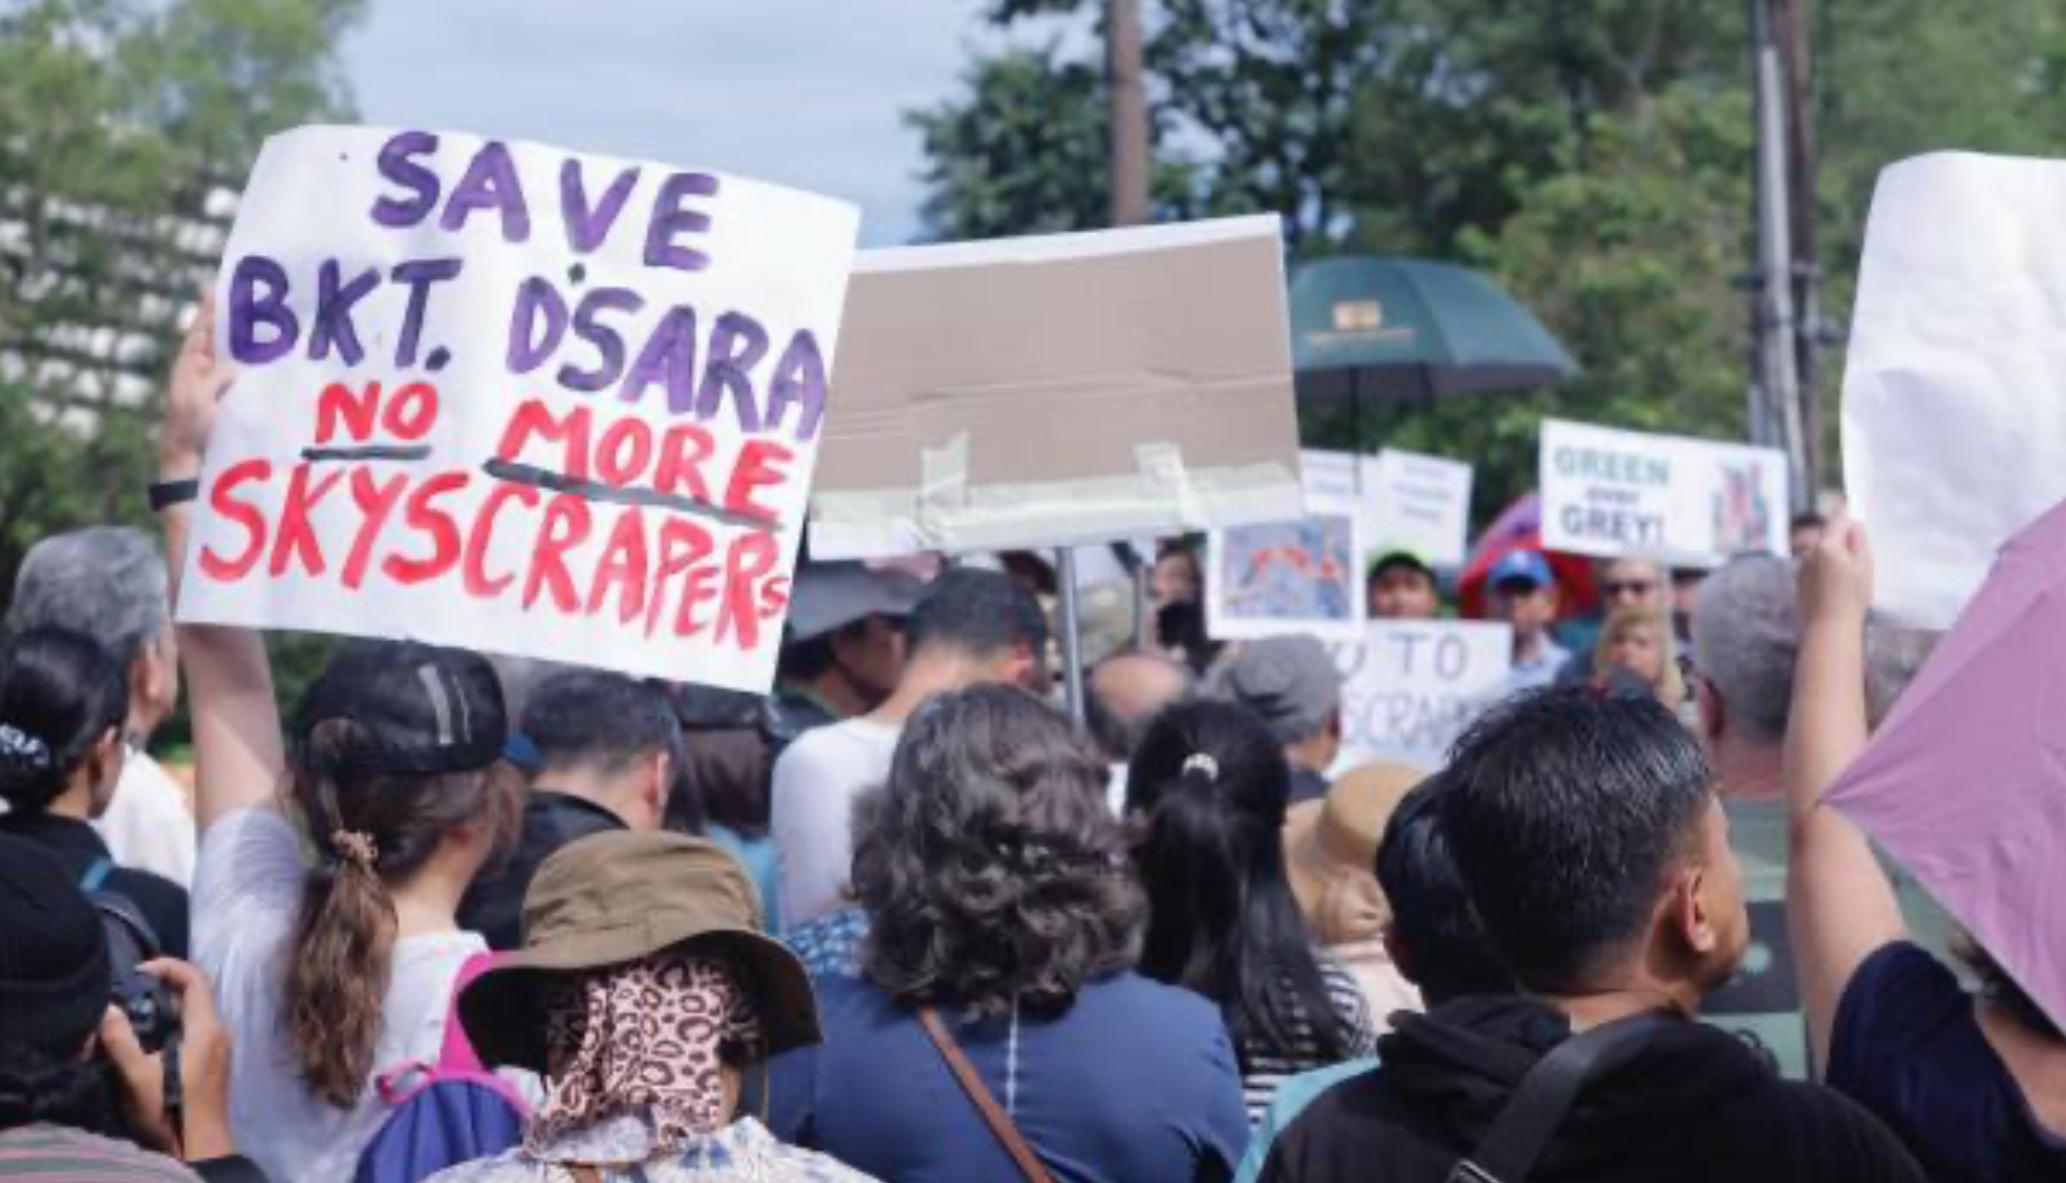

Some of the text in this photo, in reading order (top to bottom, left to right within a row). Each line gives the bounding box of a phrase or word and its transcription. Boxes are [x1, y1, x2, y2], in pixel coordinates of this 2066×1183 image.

[370, 130, 719, 271] SAVE
[227, 255, 463, 371] BKT.
[314, 380, 794, 522] NO MORE
[1555, 446, 1669, 485] GREEN
[198, 458, 789, 650] SKYSCRAPERS
[1388, 631, 1469, 682] TO
